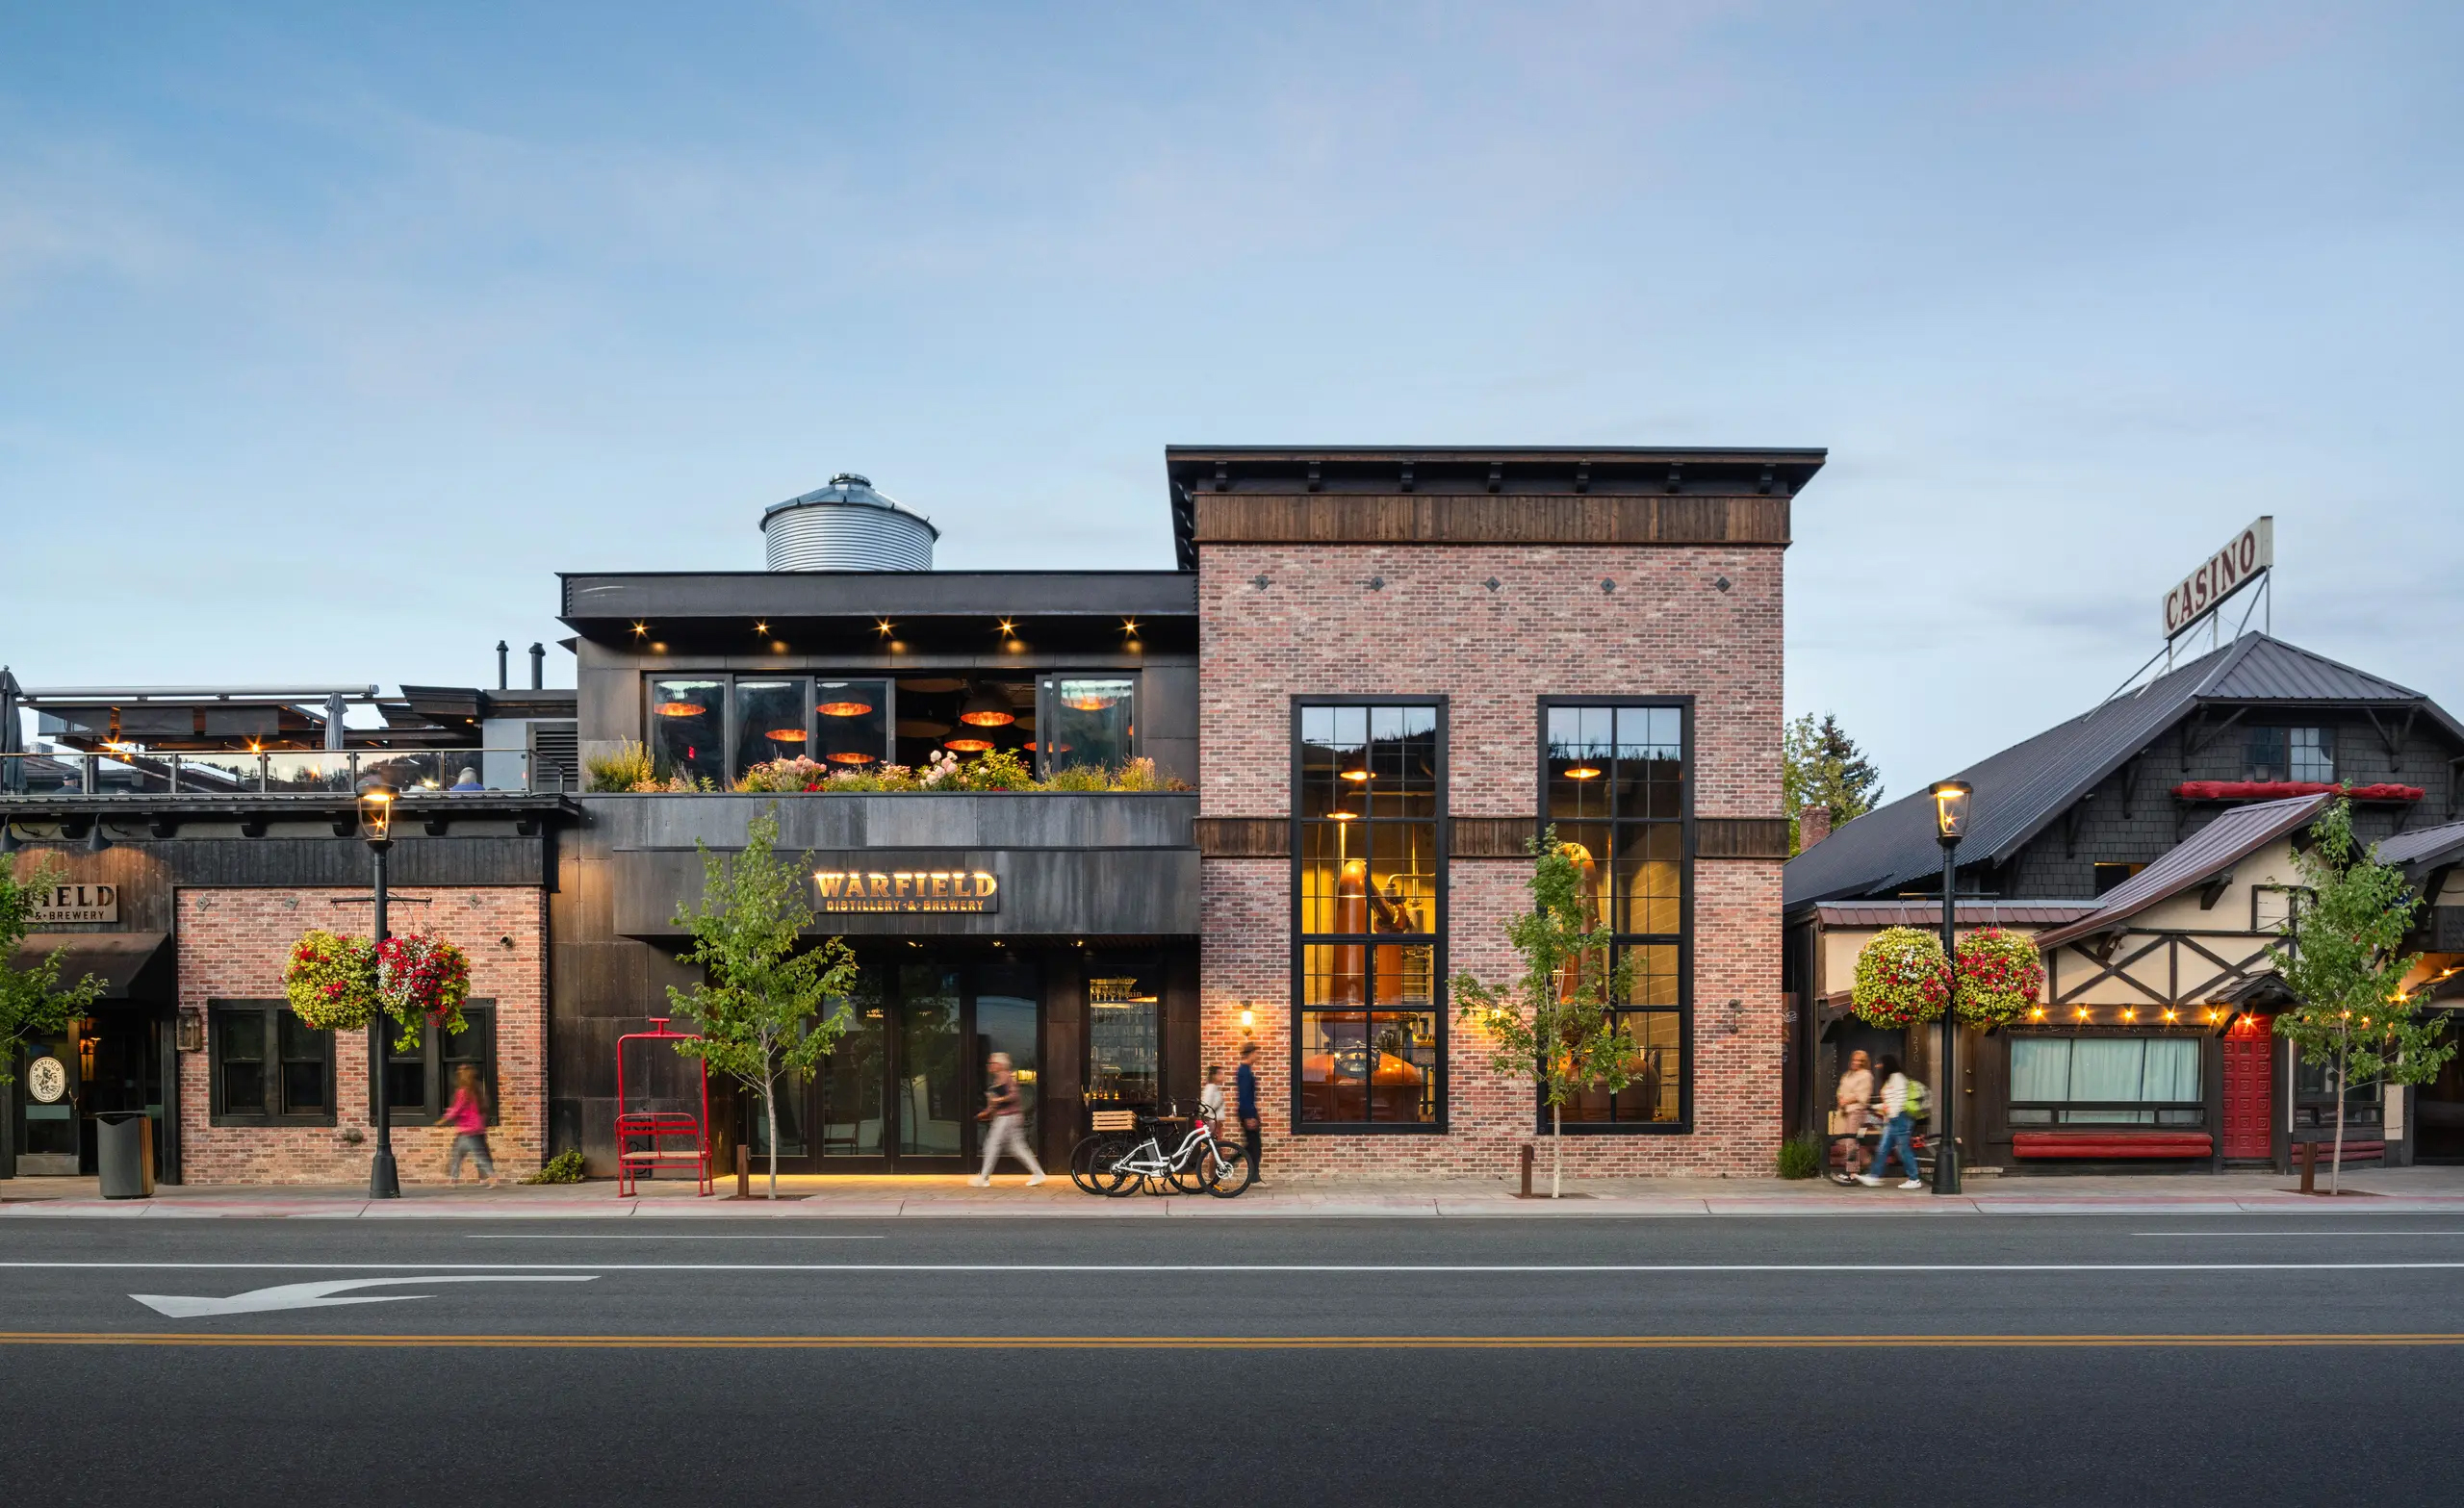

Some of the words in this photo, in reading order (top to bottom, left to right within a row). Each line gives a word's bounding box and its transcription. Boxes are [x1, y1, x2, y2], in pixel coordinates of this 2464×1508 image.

[2167, 530, 2255, 630] CASINO
[816, 872, 997, 898] WARFIELD
[826, 900, 901, 911] DISTILLERY
[923, 900, 985, 911] BREWERY
[49, 910, 105, 920] BREWERY
[33, 1060, 61, 1072] WARFIELD
